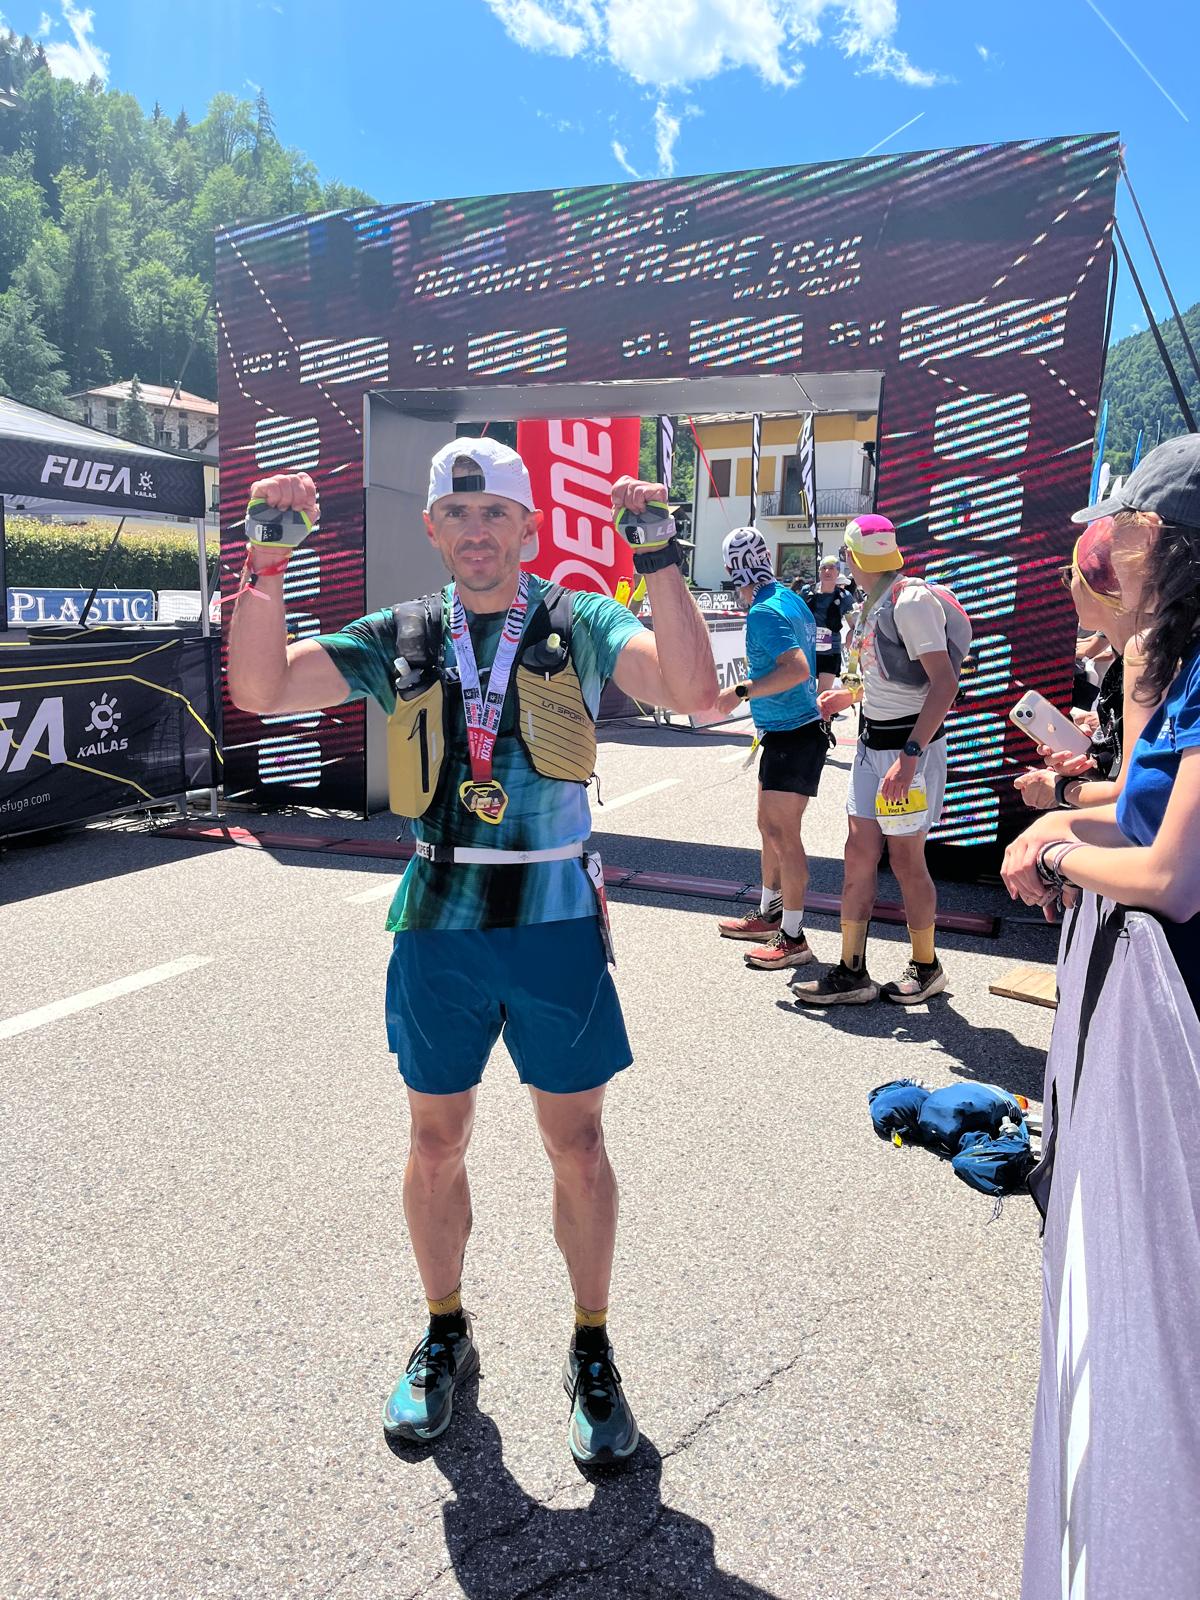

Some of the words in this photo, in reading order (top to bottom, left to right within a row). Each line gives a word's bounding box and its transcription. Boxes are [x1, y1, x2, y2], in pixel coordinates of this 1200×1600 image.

[40, 454, 131, 495] FUGA
[134, 490, 157, 499] KAILAS
[797, 521, 845, 529] GAETTINO
[11, 592, 149, 623] PLASTIC
[541, 700, 555, 710] LA
[557, 706, 592, 727] SPORT
[77, 738, 129, 759] KAILAS
[480, 735, 494, 761] 103K
[0, 792, 51, 813] sfuga.com
